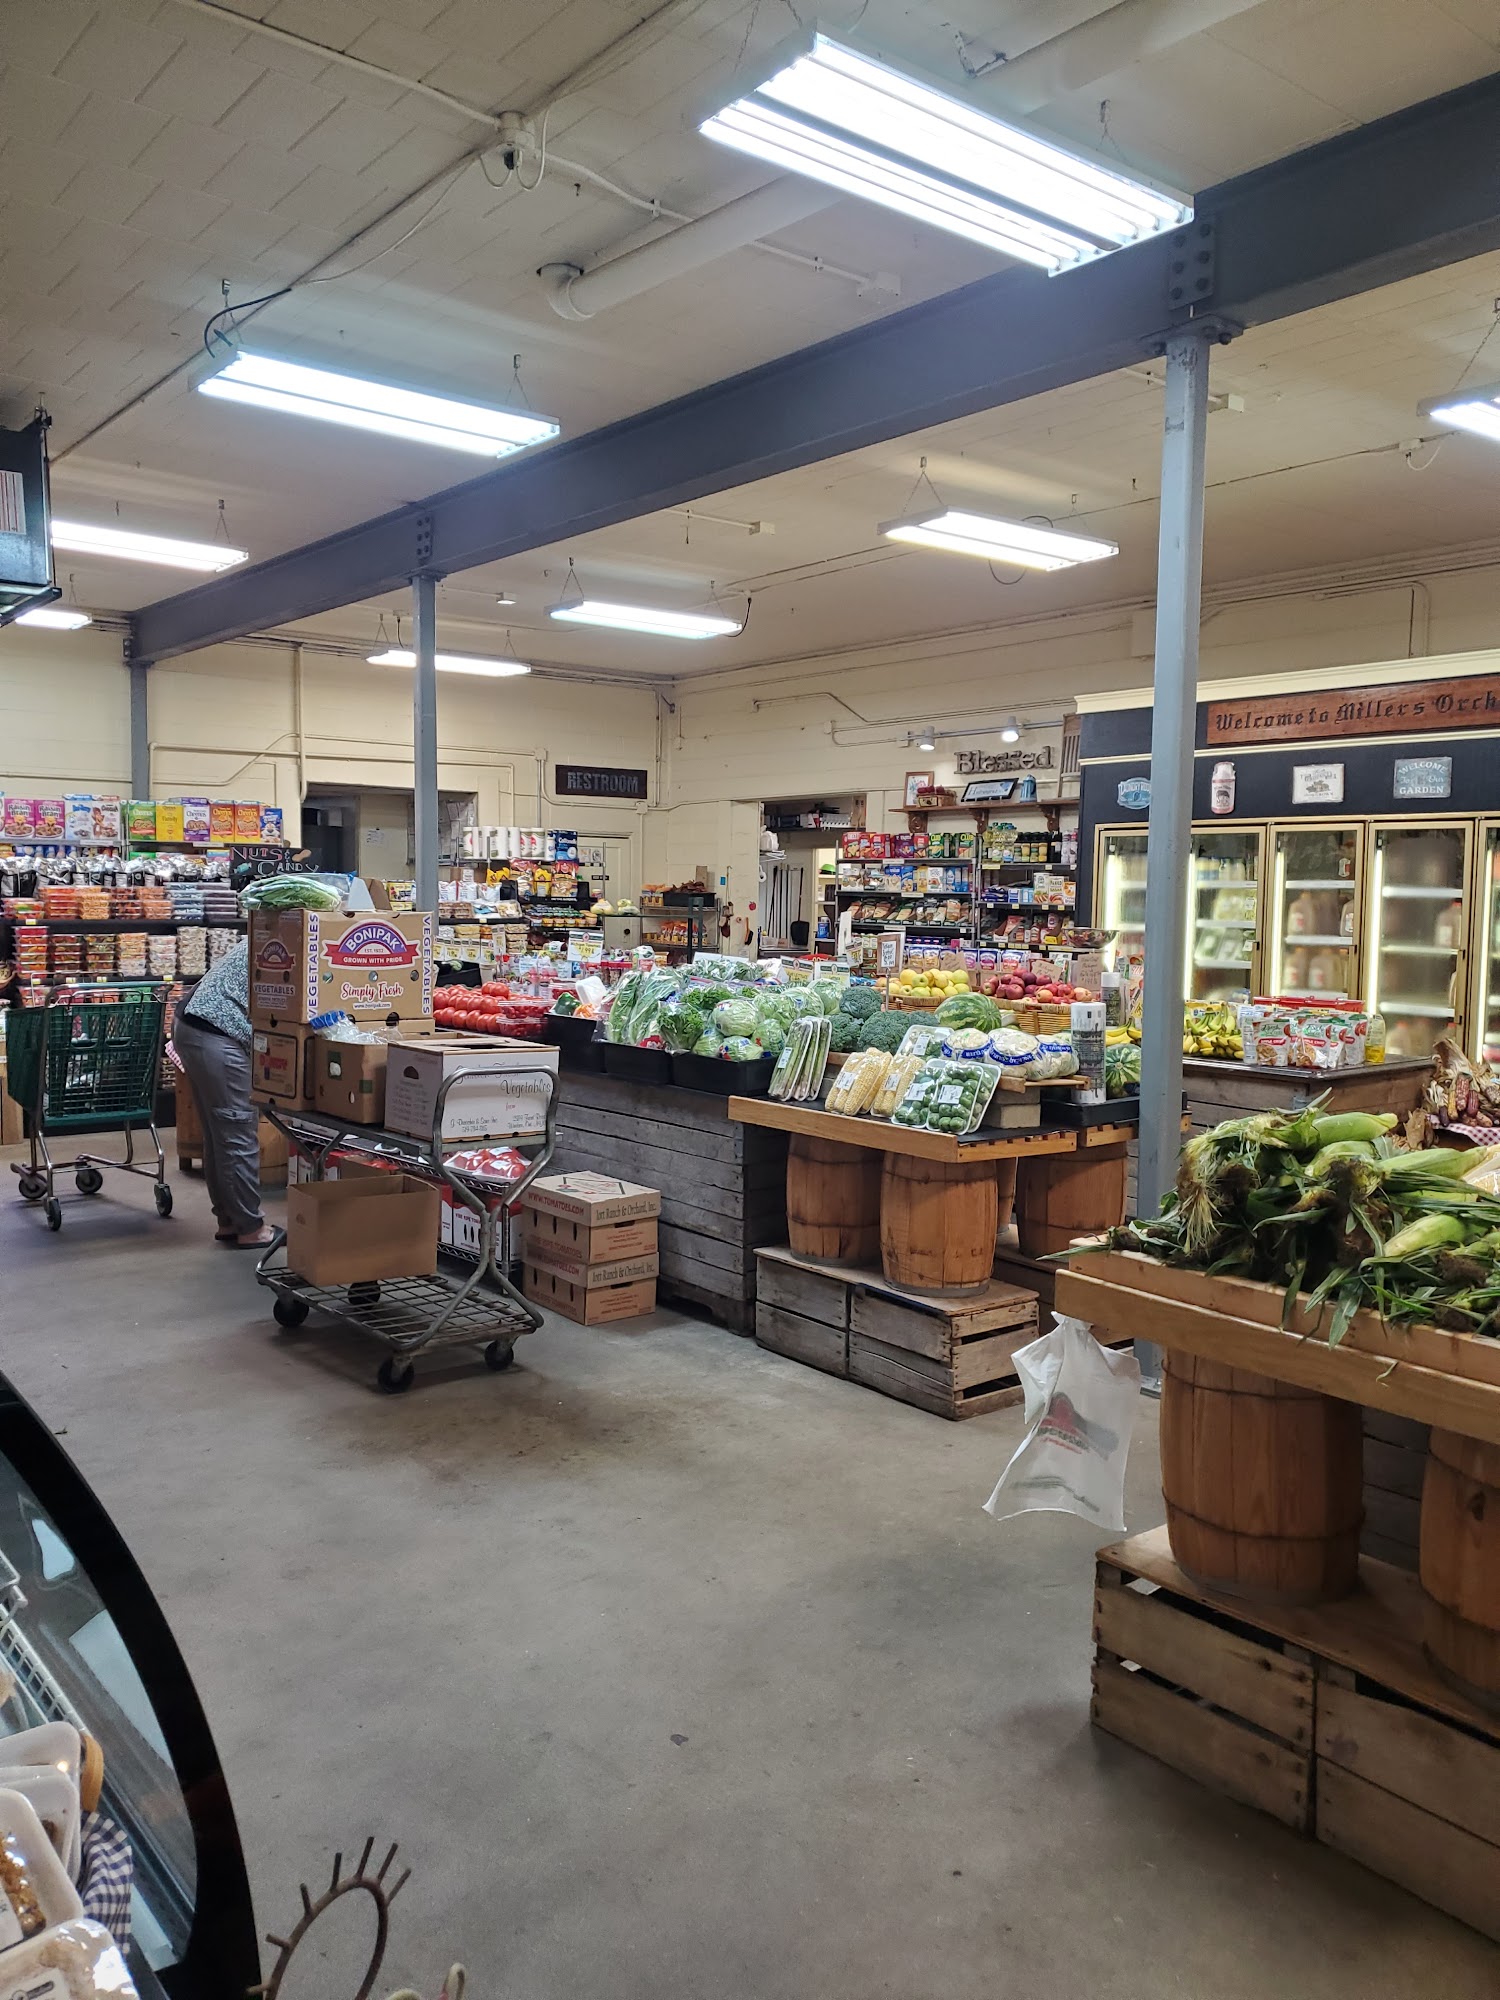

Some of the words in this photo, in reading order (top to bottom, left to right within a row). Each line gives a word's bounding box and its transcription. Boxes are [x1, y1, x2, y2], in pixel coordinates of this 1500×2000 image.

[1216, 711, 1304, 731] Welcome
[1308, 707, 1329, 724] to
[953, 745, 1055, 775] Blessed
[1398, 761, 1448, 774] WELCOME
[567, 771, 639, 793] RESTROOM
[1400, 785, 1444, 795] GARDEN
[39, 805, 61, 813] Raisin
[230, 846, 283, 862] NUTS
[257, 861, 319, 877] CANDY
[345, 927, 400, 951] BONIPAK
[309, 913, 319, 1020] VEGETABLES
[343, 956, 368, 964] GROWN
[423, 916, 431, 1014] VEGETABLES
[254, 984, 294, 995] VEGETABLES
[342, 983, 375, 1001] Simply
[378, 982, 402, 999] Fresh
[501, 1079, 551, 1098] Vegetables
[527, 1191, 584, 1216] WWW.TOMATOES.COM
[605, 1204, 621, 1219] Ranch
[621, 1207, 627, 1217] &
[648, 1202, 657, 1212] Inc.
[603, 1265, 618, 1280] Ranch
[618, 1268, 624, 1278] &
[646, 1263, 655, 1273] Inc.
